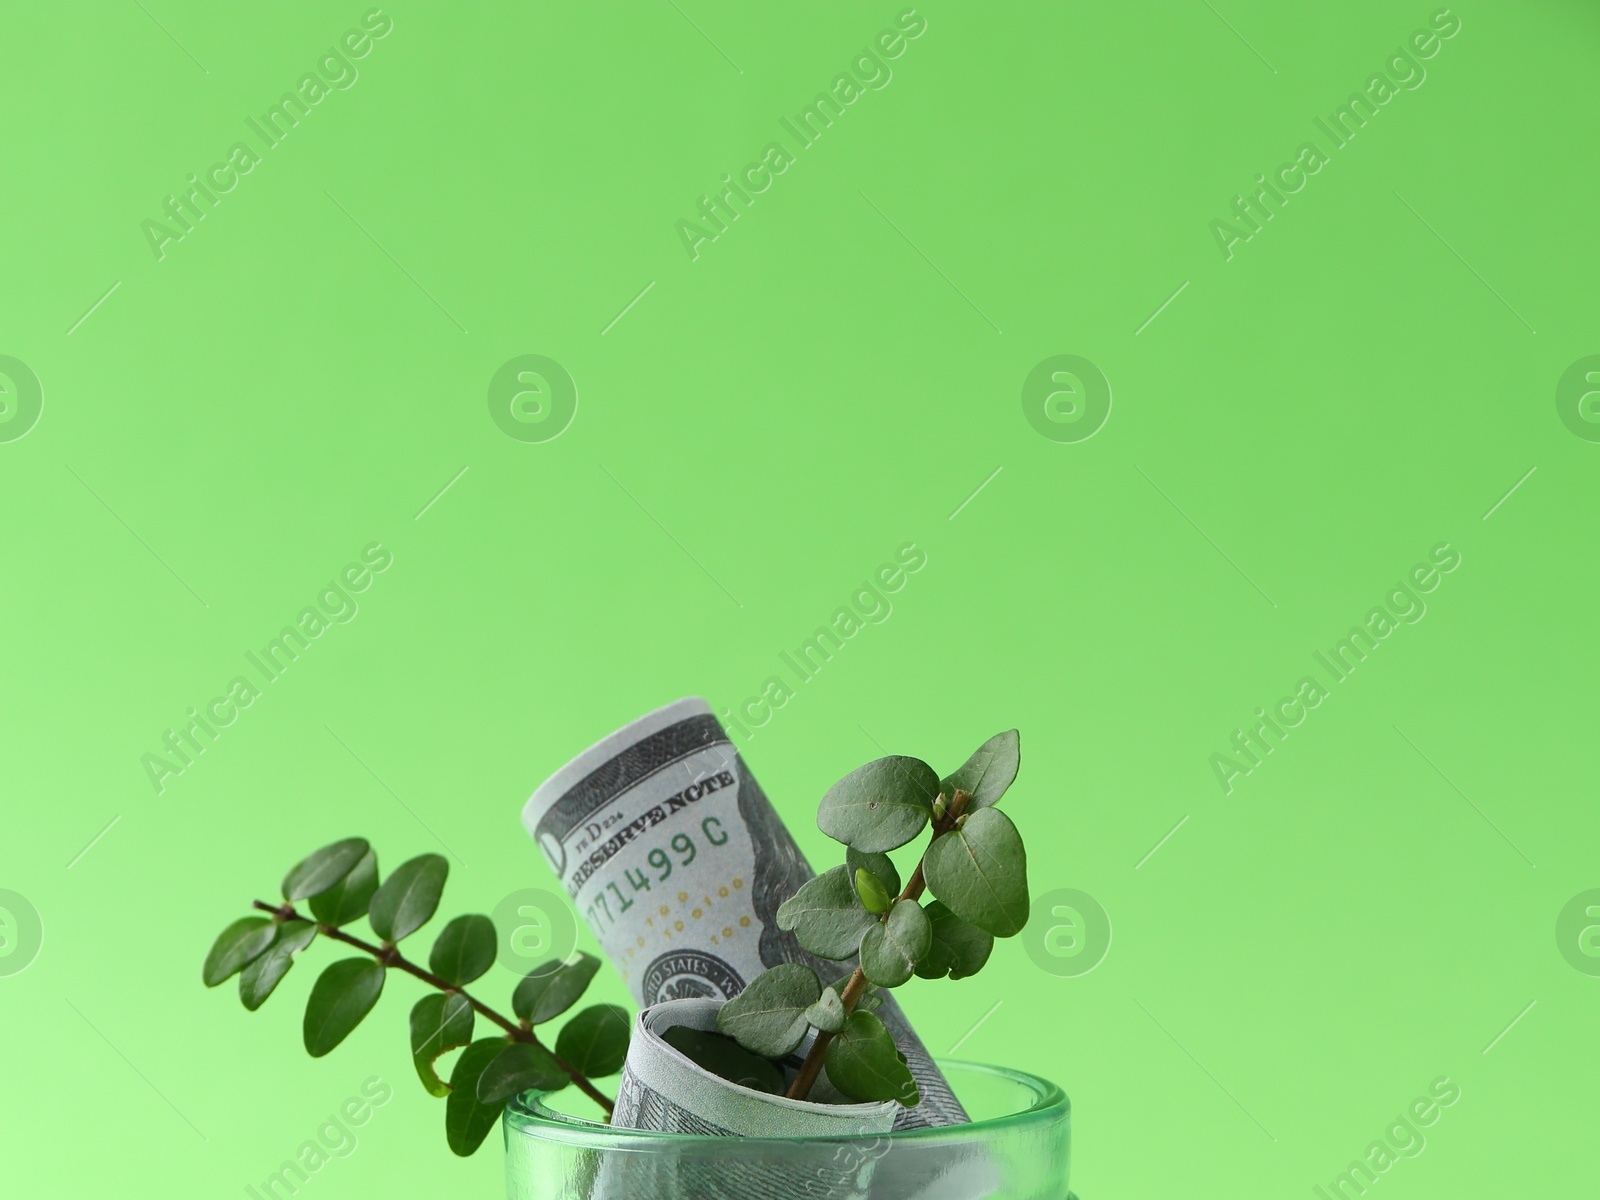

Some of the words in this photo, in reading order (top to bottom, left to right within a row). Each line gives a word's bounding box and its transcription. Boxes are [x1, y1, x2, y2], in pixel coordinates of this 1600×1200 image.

[571, 803, 667, 890] RESERVE
[662, 770, 736, 815] NOTE
[585, 823, 601, 841] D
[701, 816, 728, 846] C
[662, 958, 709, 976] STATES
